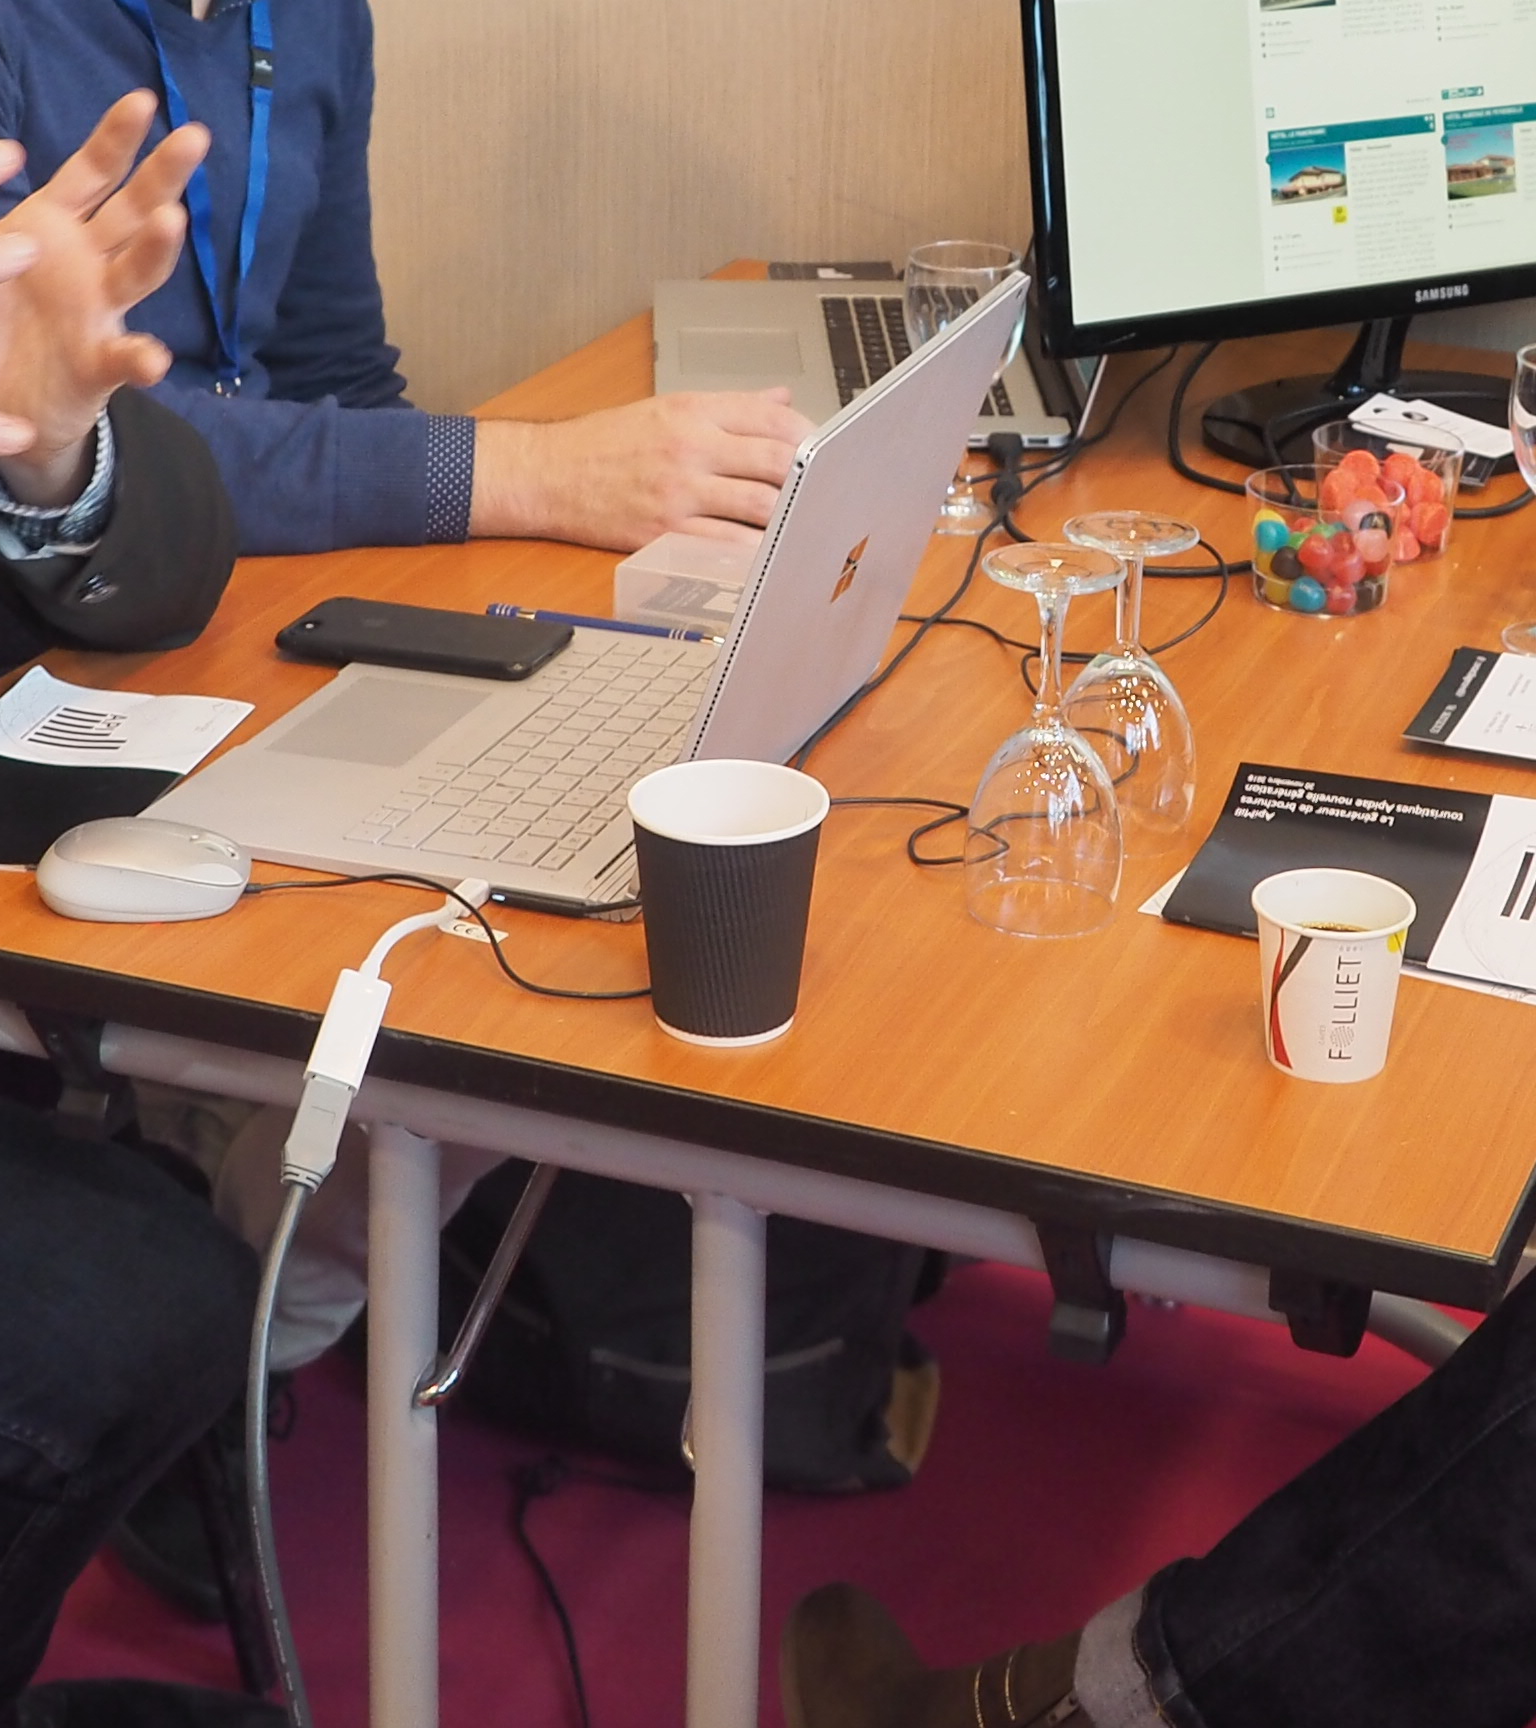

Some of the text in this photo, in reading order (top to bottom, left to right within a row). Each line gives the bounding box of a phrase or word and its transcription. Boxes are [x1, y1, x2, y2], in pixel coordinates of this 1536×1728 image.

[1415, 283, 1470, 304] SAMSUNG
[1234, 807, 1275, 822] ApiMill
[1240, 795, 1395, 827] Le générateur de brochures
[1245, 783, 1464, 822] touristiques Apidae nouvelle génération
